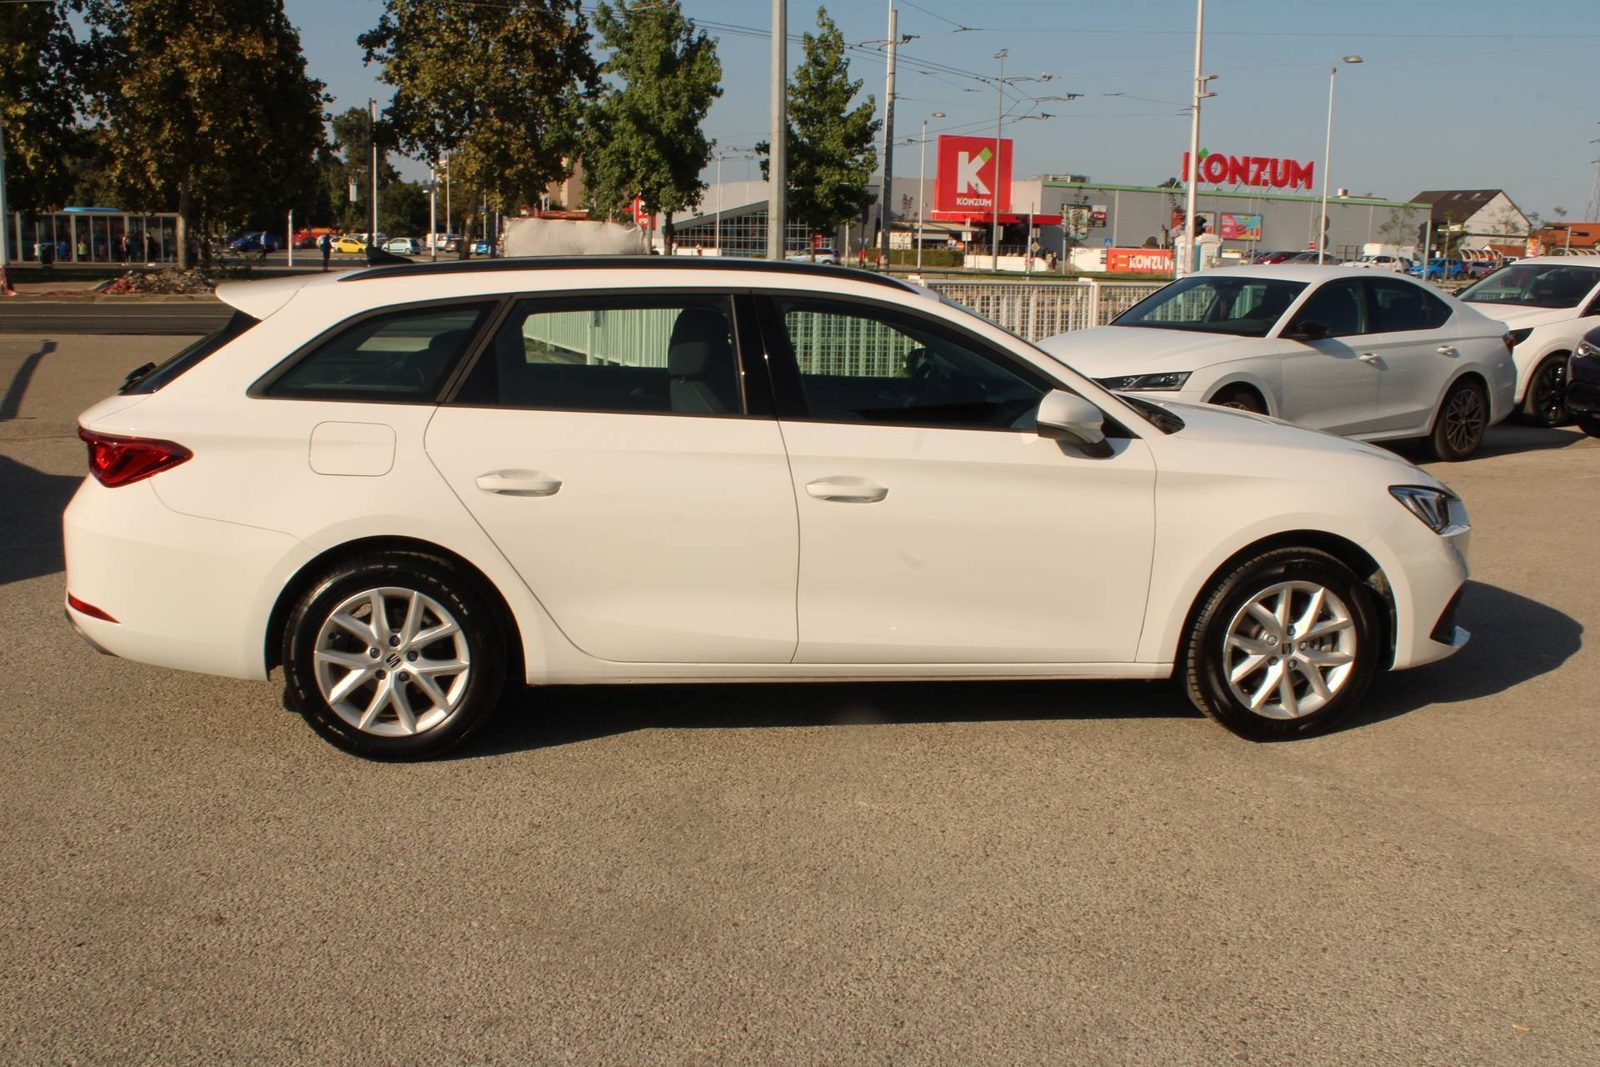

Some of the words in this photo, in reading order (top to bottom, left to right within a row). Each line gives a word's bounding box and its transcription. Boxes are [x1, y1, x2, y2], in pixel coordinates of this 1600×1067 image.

[957, 147, 992, 194] K
[1183, 148, 1314, 190] KONZUM
[956, 197, 992, 207] KONZUM
[1129, 255, 1174, 270] KONZUM
